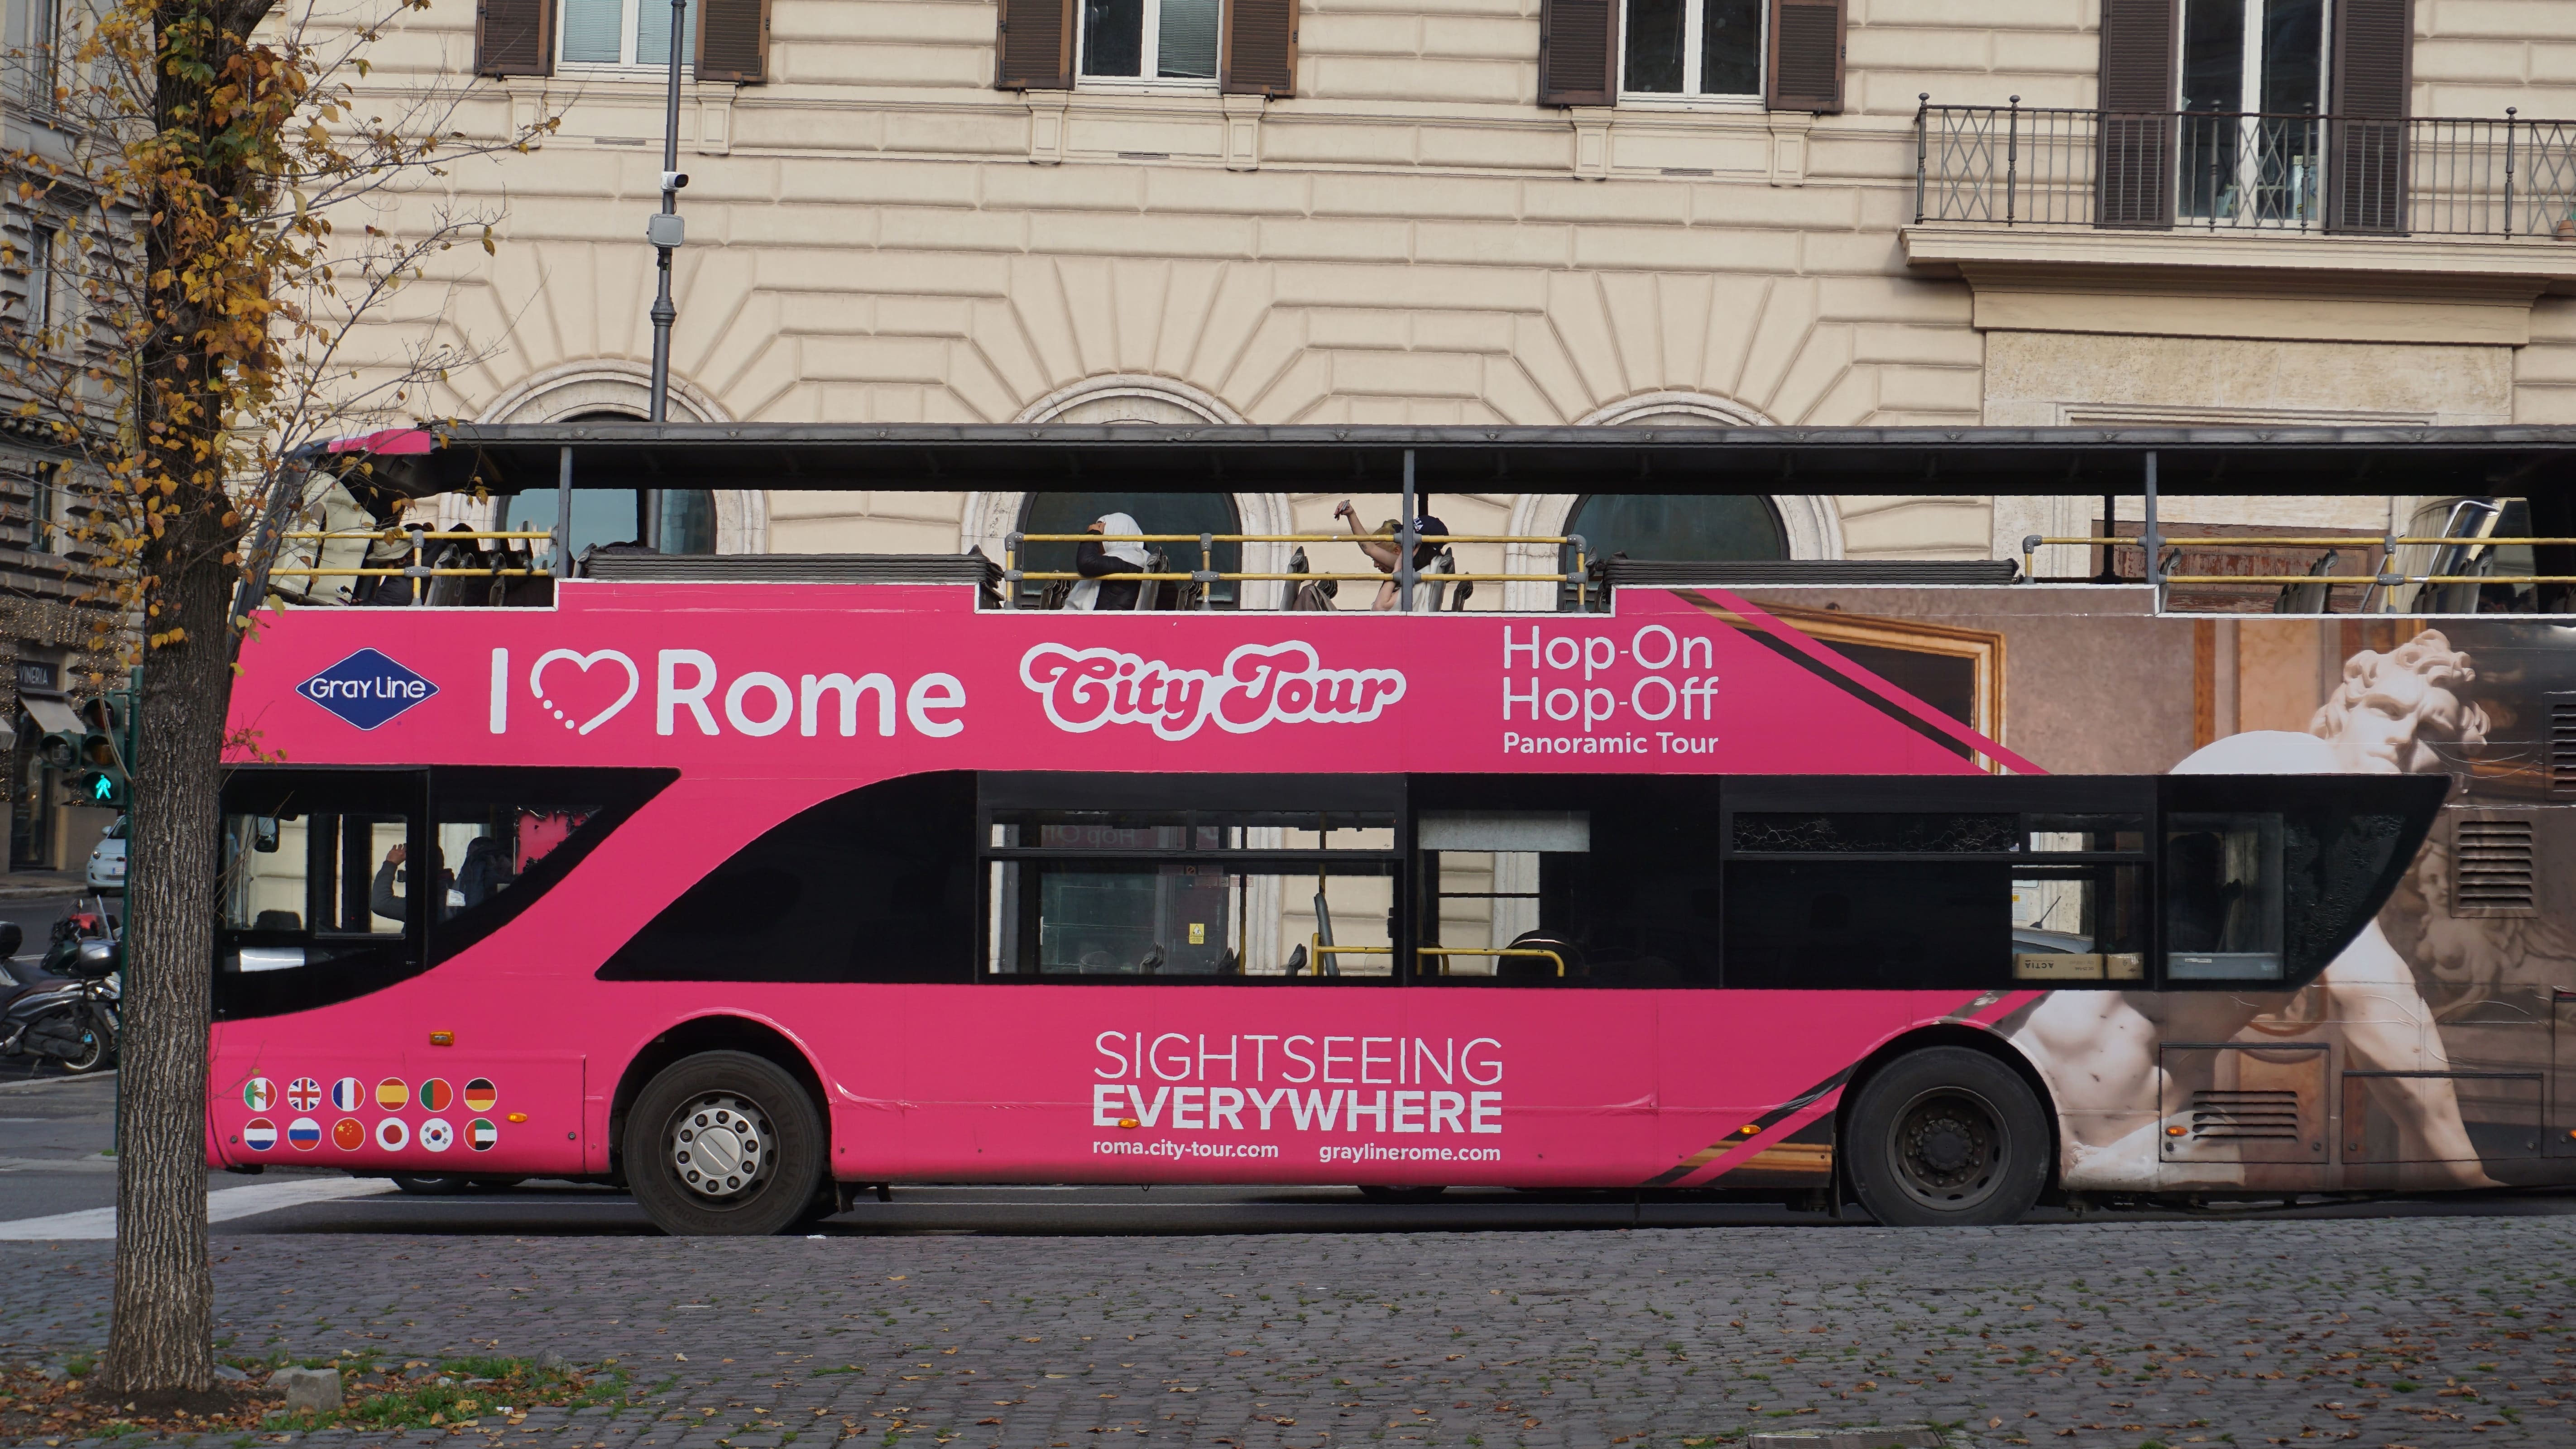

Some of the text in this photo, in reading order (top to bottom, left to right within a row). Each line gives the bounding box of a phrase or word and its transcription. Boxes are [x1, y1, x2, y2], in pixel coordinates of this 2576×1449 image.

[19, 665, 48, 685] VINERIA
[1503, 625, 1713, 681] Hop-On
[376, 676, 426, 698] Line
[489, 647, 966, 738] I Rome
[1020, 640, 1406, 741] City Tour
[1503, 676, 1719, 732] Hop-Off
[1504, 732, 1718, 754] Panoramic Tour
[1094, 1031, 1502, 1085] SIGHTSEEING
[1093, 1084, 1502, 1133] EVERYWHERE
[1093, 1138, 1279, 1160] roma.city-tour.com
[1319, 1143, 1501, 1163] graylinerome.com
